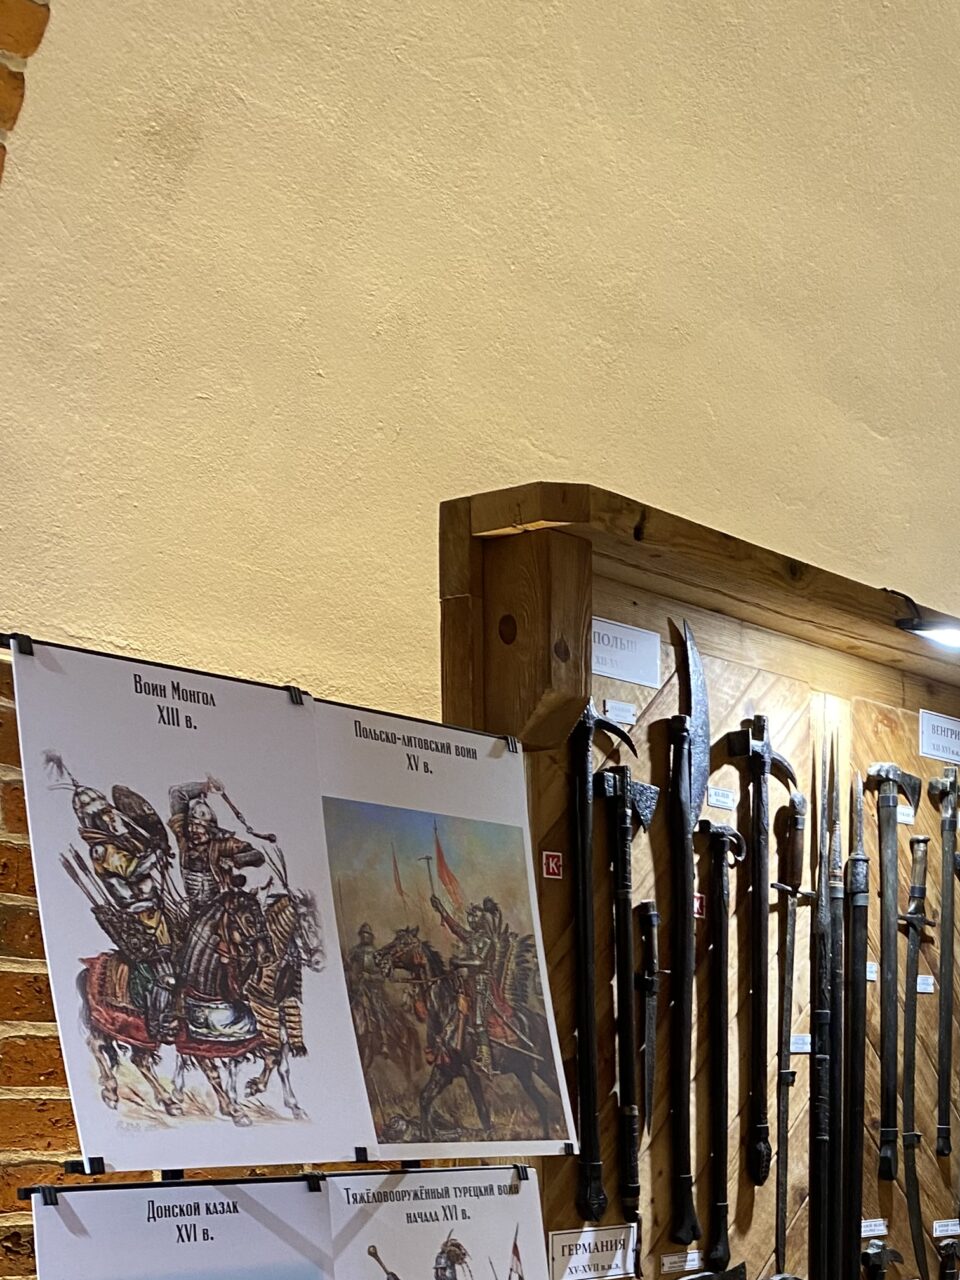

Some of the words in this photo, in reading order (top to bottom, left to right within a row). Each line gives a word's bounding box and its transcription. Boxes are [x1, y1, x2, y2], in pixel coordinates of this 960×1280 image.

[593, 631, 639, 653] ПОЛЬШ
[133, 673, 167, 698] Воин
[171, 681, 216, 707] Монгол
[157, 704, 180, 727] XIII
[185, 715, 197, 729] в.
[354, 720, 452, 755] Польско-литовский
[455, 745, 478, 760] воин
[406, 753, 419, 771] XV
[423, 761, 433, 774] в.
[549, 857, 558, 874] К
[344, 1185, 450, 1205] Тяжёловооружённый
[453, 1184, 495, 1200] турецкий
[497, 1183, 520, 1196] воин
[147, 1200, 201, 1222] Донской
[205, 1201, 239, 1215] казак
[406, 1210, 440, 1224] начала
[441, 1204, 458, 1221] XVI
[462, 1208, 471, 1221] в.
[176, 1223, 198, 1243] XVI
[202, 1228, 214, 1241] в.
[561, 1238, 626, 1257] ГЕРМАНИЯ
[568, 1263, 600, 1275] XV-XVII
